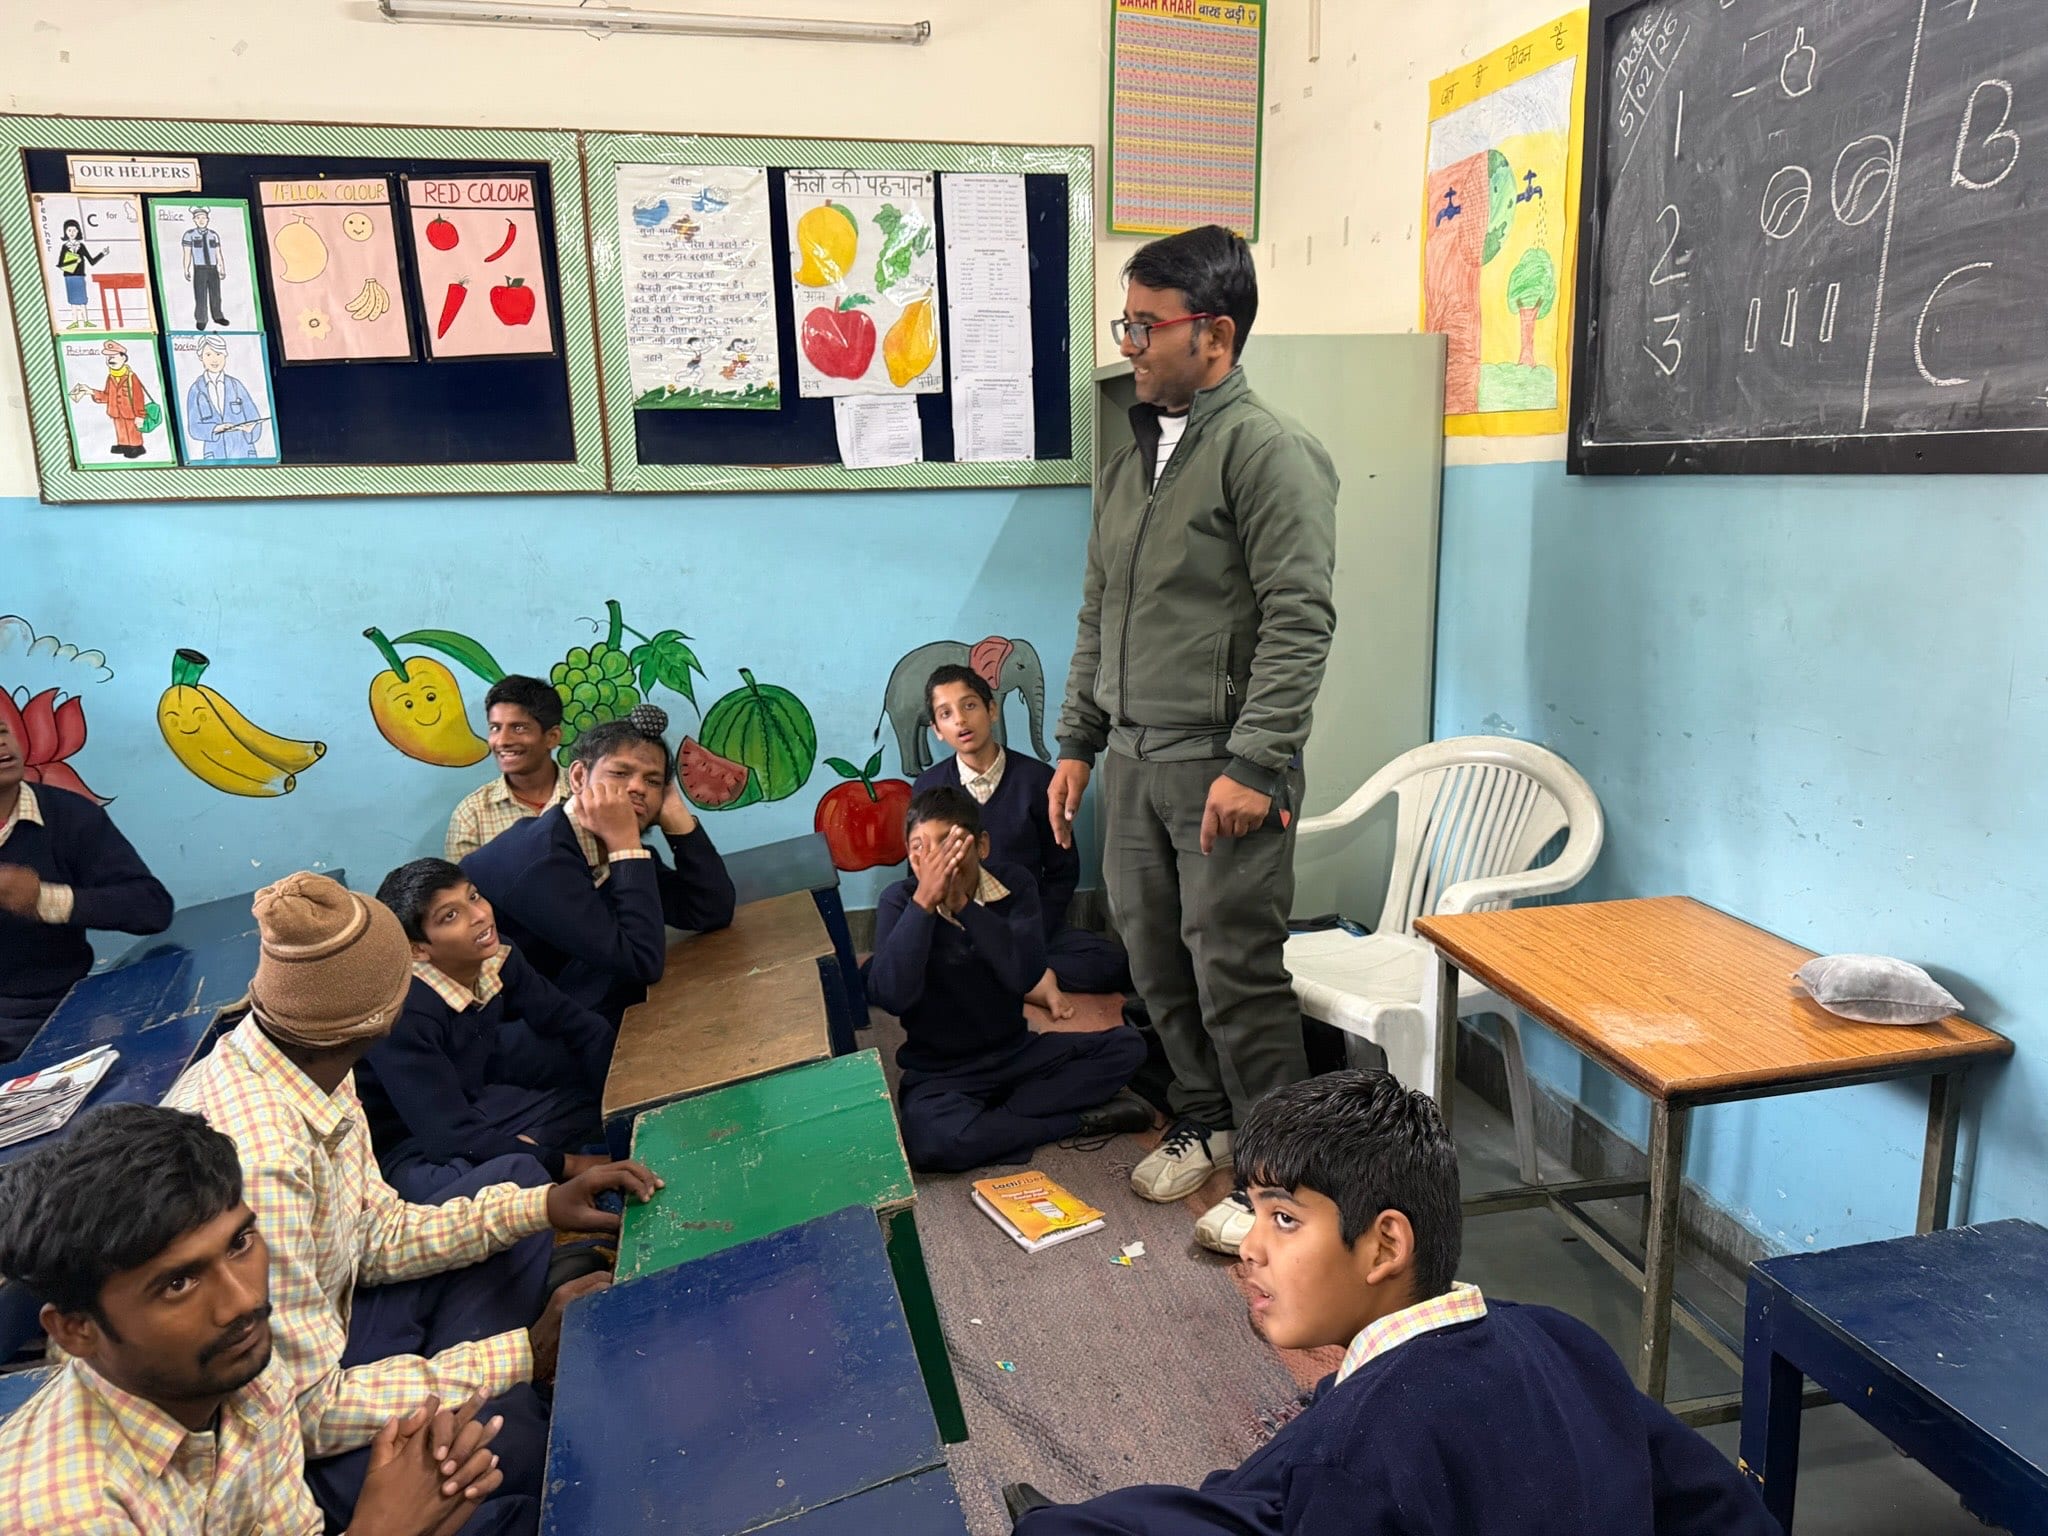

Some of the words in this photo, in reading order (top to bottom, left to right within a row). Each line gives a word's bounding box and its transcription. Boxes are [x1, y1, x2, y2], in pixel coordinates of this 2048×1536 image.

[1161, 0, 1196, 15] KHARI
[1505, 45, 1533, 71] जीवन
[1550, 22, 1567, 50] है
[1615, 14, 1653, 89] Date
[1951, 79, 2021, 190] B
[80, 165, 114, 178] OUR
[119, 166, 191, 179] HELPERS
[830, 170, 861, 194] की
[863, 176, 924, 197] पहचान
[335, 183, 386, 201] COLOUR
[424, 182, 461, 204] RED
[467, 182, 530, 203] COLOUR
[87, 213, 99, 227] C
[158, 208, 185, 221] Police
[1650, 205, 1687, 286] 2
[1914, 262, 1994, 387] C
[1643, 314, 1681, 375] 3
